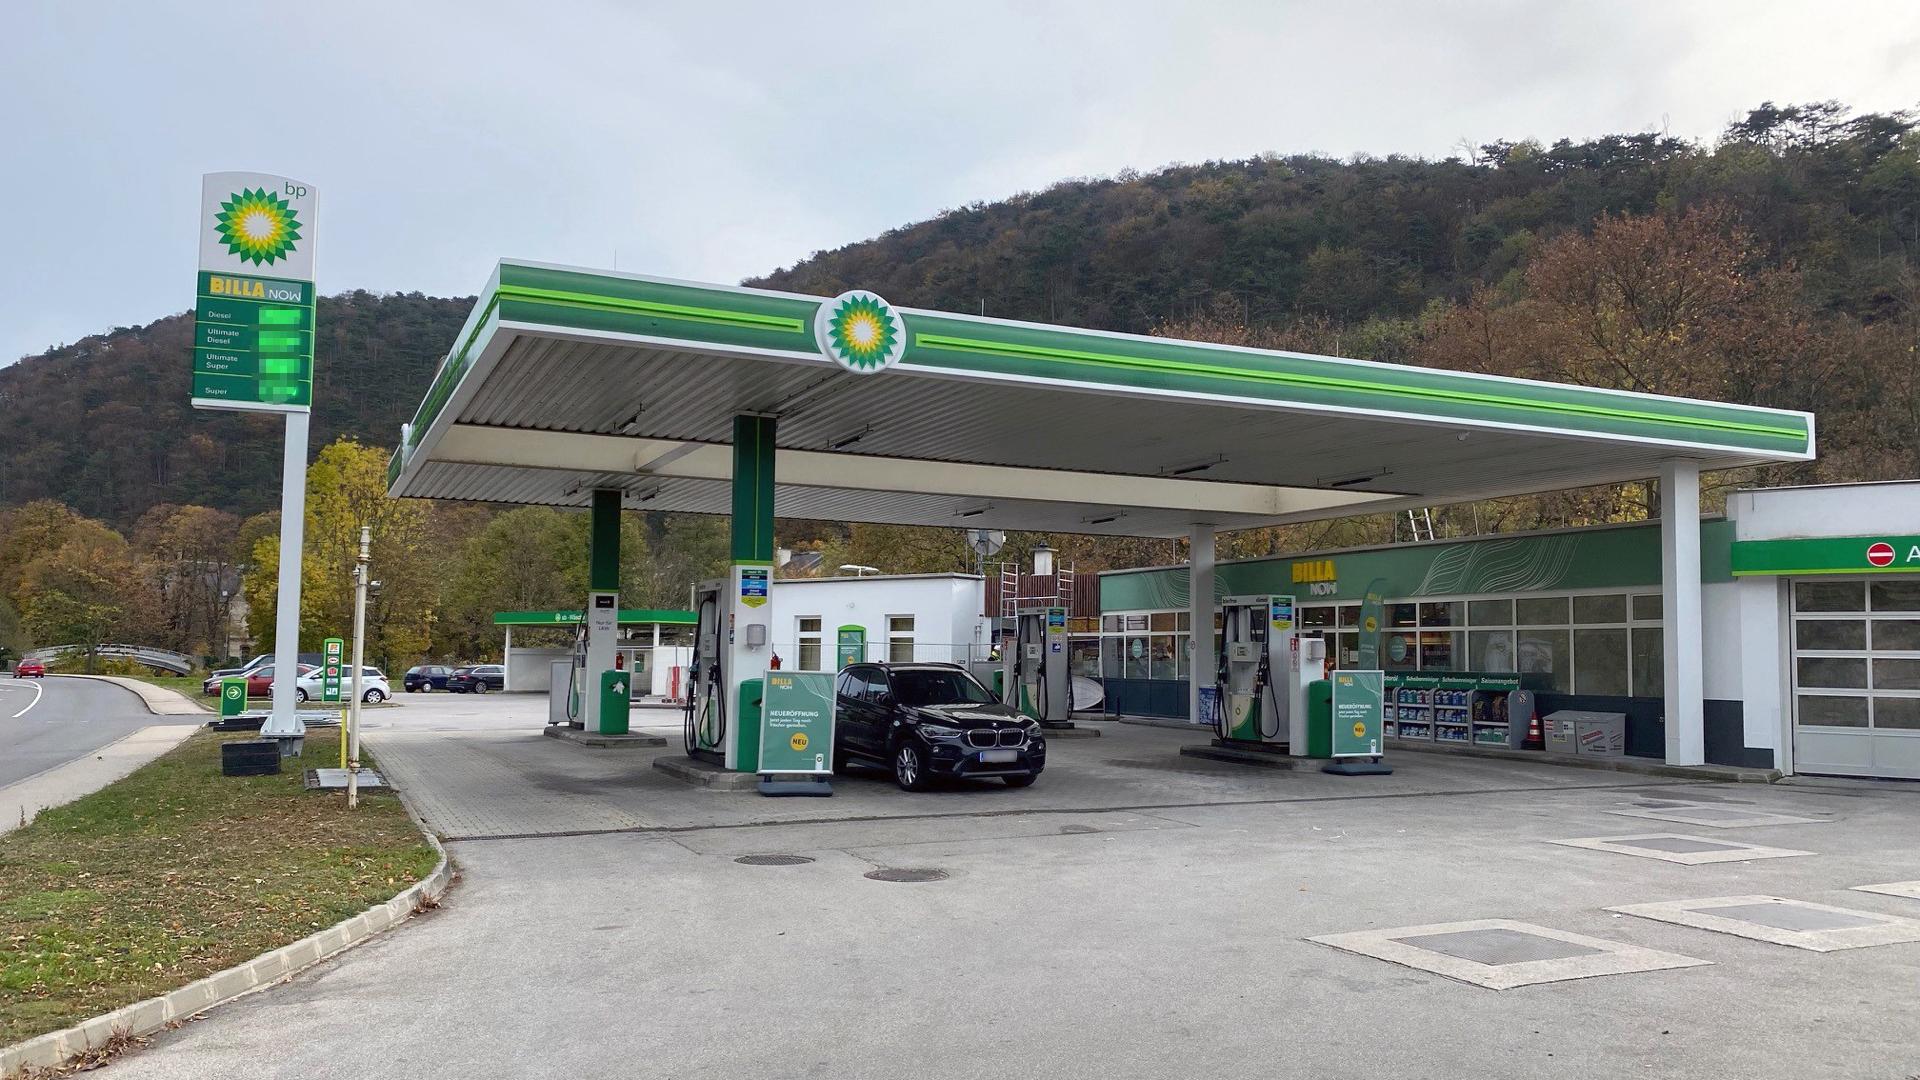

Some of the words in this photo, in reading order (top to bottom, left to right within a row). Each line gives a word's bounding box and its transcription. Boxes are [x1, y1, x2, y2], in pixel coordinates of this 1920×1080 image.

[284, 181, 307, 199] bp
[209, 274, 265, 298] BILLA
[269, 288, 302, 302] NOW
[208, 310, 231, 319] Diesel
[207, 328, 239, 337] Ultimate
[207, 336, 231, 345] Diesel
[206, 353, 238, 362] Ultimate
[206, 361, 229, 371] Super
[204, 387, 228, 396] Super
[1292, 560, 1337, 583] BILLA
[1310, 582, 1338, 596] NOW
[771, 677, 793, 686] BILLA
[770, 710, 819, 718] NEUERÖFFNUNG
[792, 738, 807, 746] NEU
